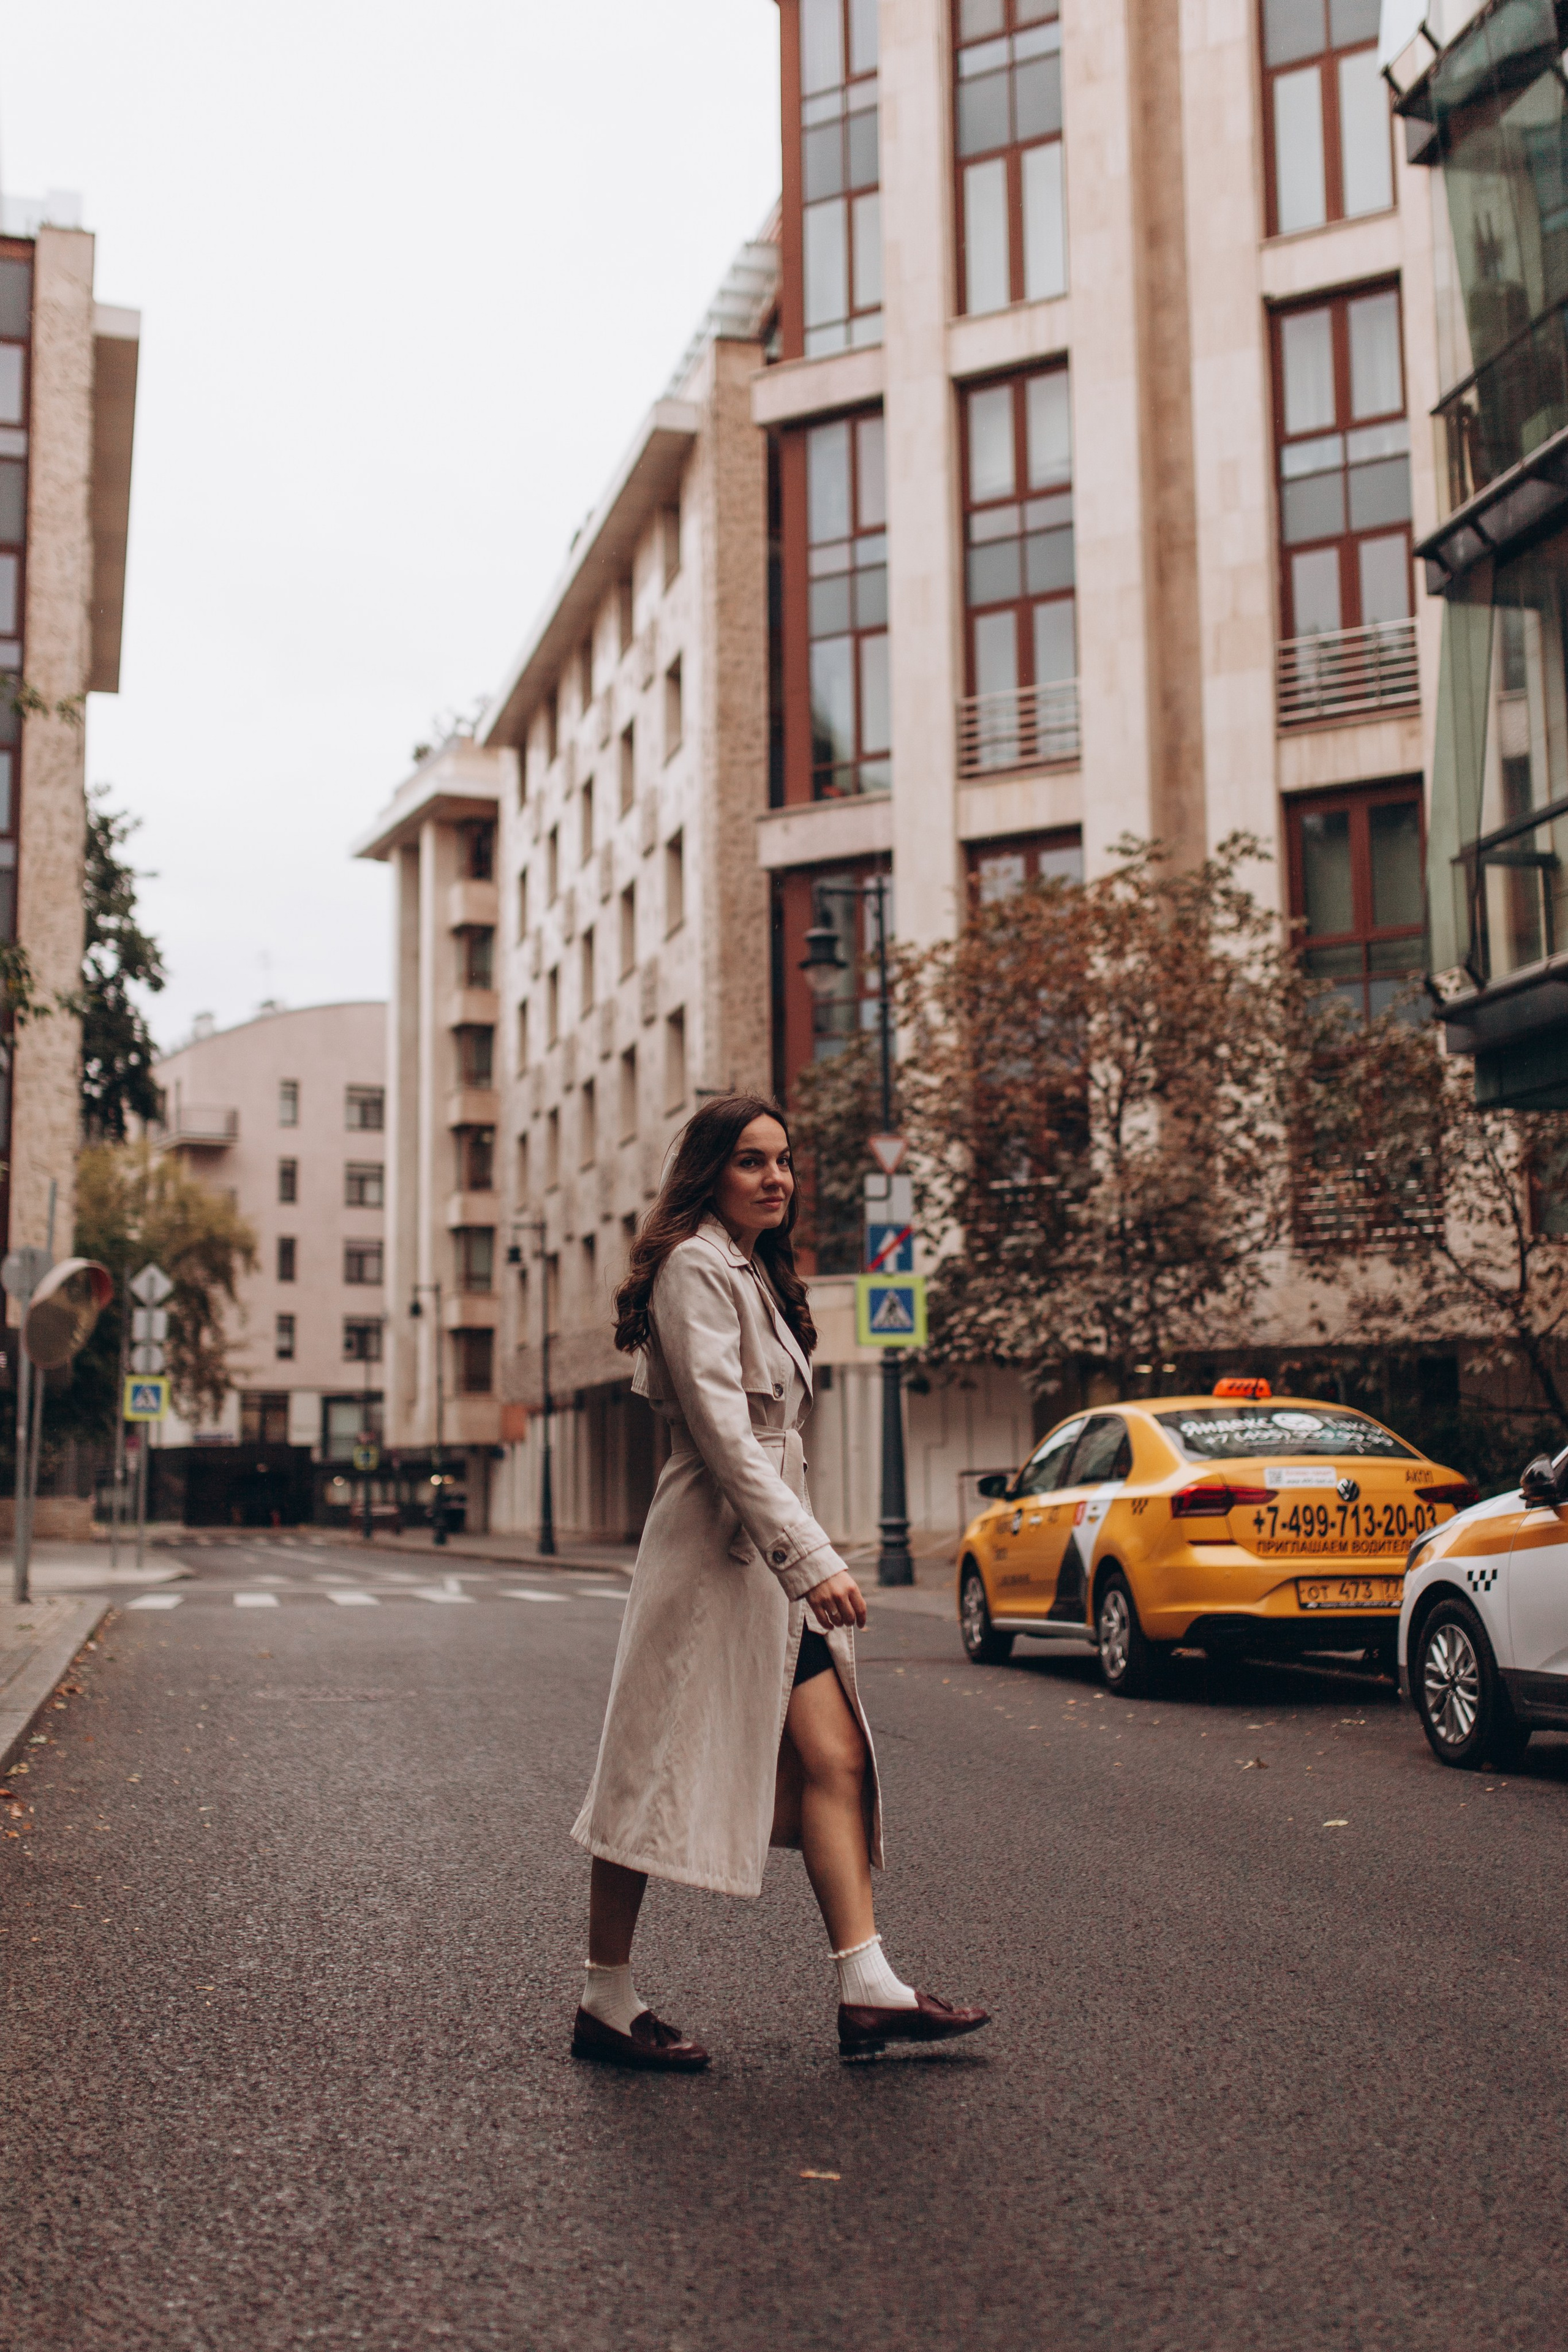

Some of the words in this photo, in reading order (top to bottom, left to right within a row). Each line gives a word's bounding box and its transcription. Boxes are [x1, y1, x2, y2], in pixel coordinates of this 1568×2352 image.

[1180, 1417, 1275, 1438] Яндекс
[1253, 1504, 1437, 1538] +7-499-713-20-03
[1256, 1539, 1348, 1554] ПРИГЛАШАЕМ
